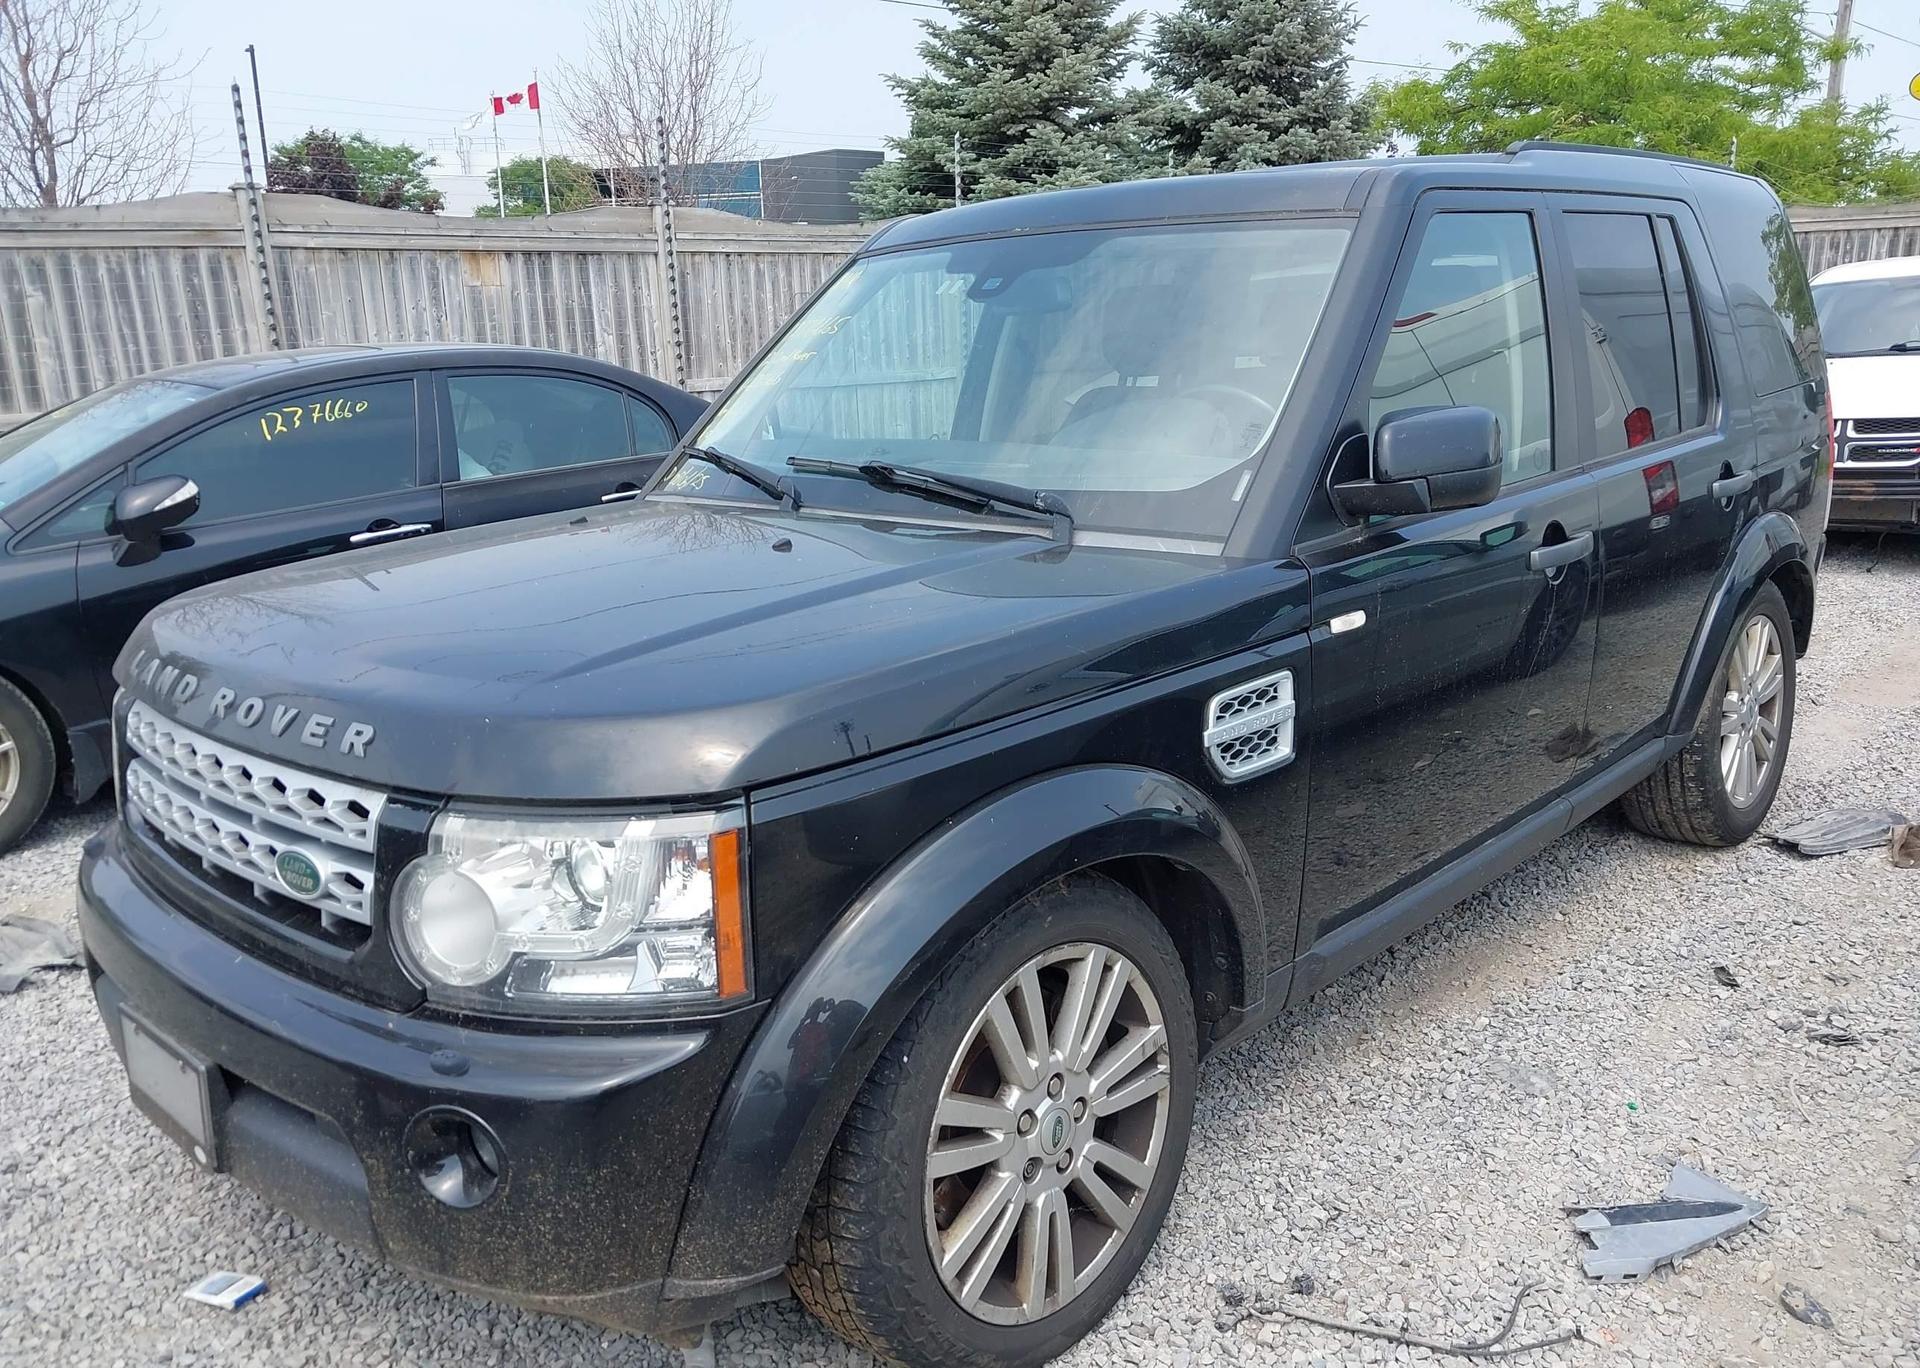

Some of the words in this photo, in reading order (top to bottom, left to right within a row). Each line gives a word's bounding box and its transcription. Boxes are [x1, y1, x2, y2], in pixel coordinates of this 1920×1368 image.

[130, 649, 198, 704] LAND
[209, 686, 376, 759] ROVER
[285, 870, 314, 890] ROVER
